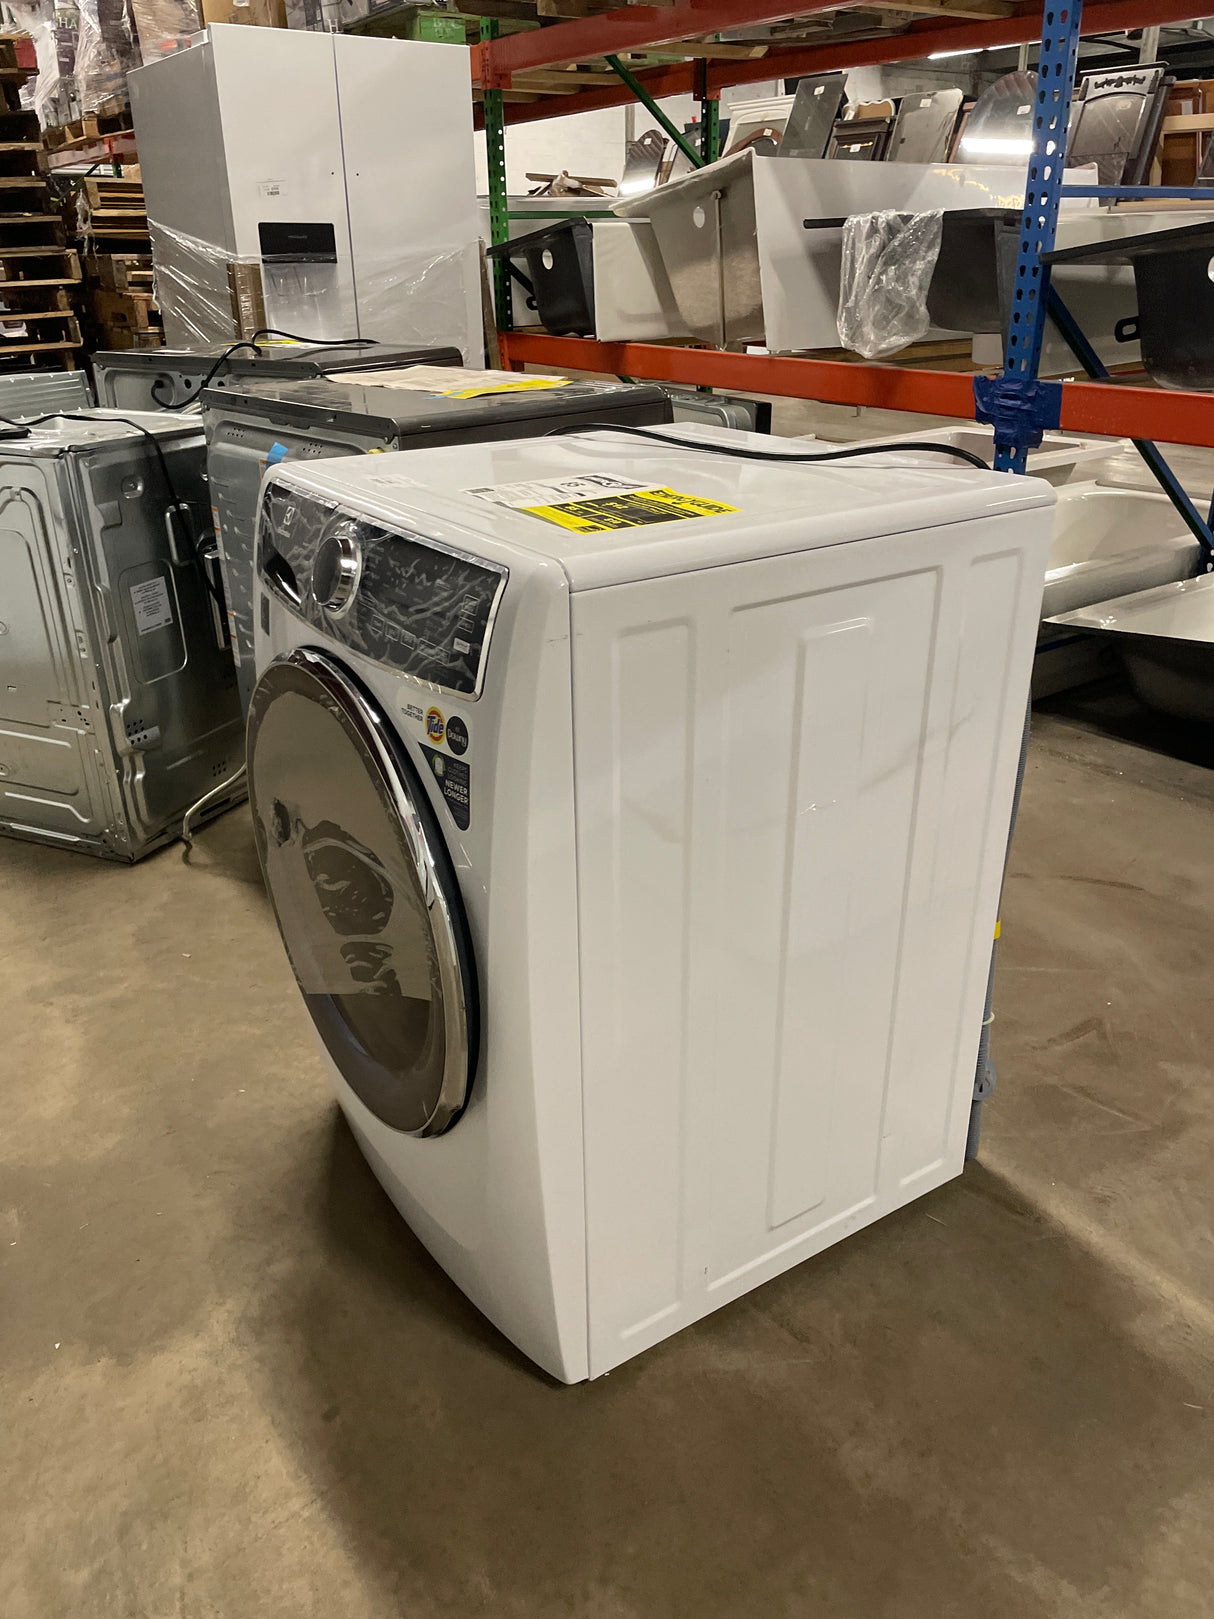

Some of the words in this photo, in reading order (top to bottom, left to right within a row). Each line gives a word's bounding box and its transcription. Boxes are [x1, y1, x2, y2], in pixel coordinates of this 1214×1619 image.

[401, 707, 423, 721] TOGETHER
[407, 704, 423, 715] BETTER
[427, 715, 444, 735] Tide
[447, 729, 467, 747] Downy
[445, 779, 468, 795] NEWER
[443, 787, 468, 805] LONGER
